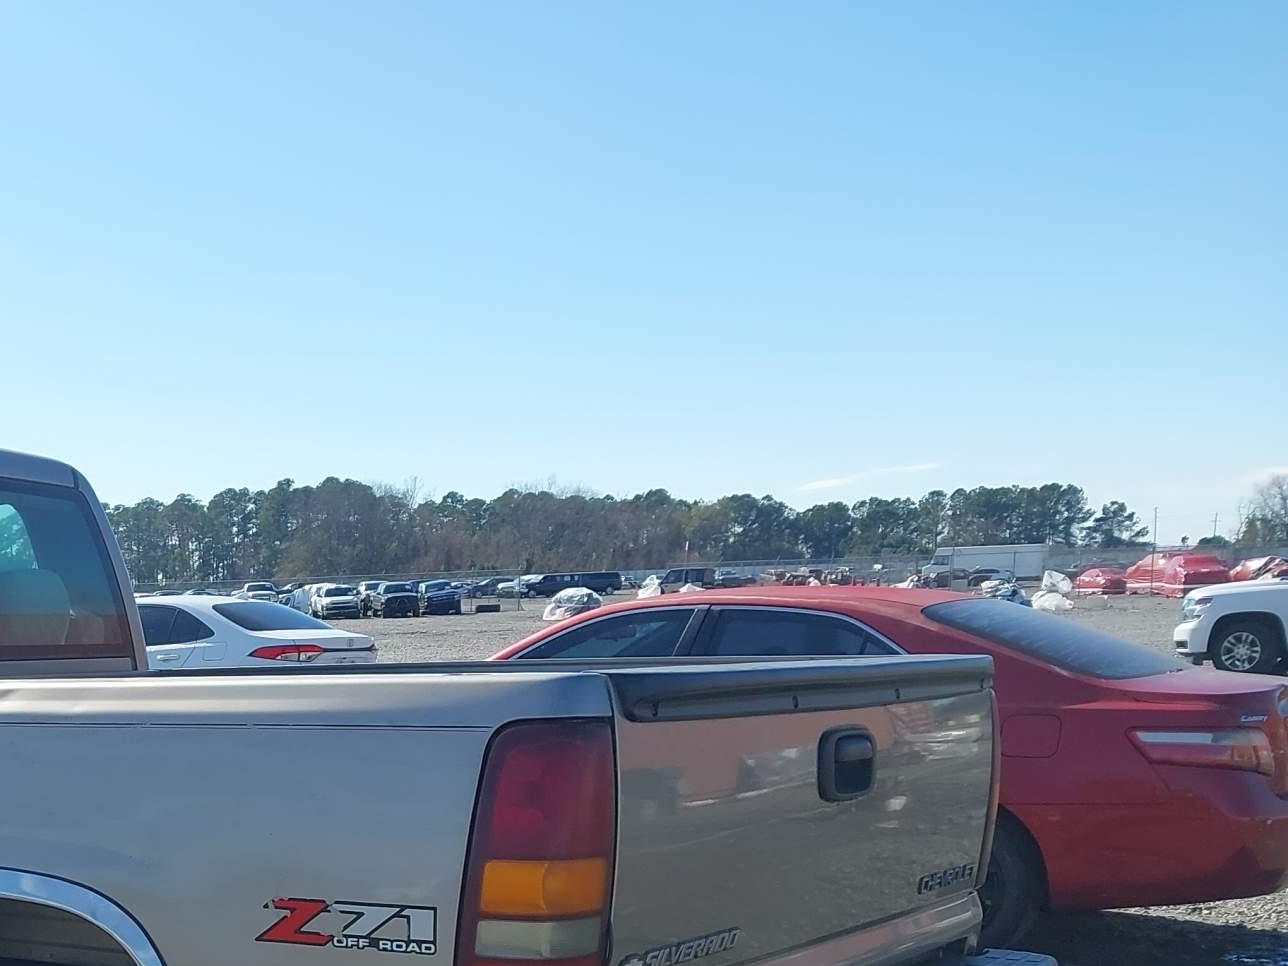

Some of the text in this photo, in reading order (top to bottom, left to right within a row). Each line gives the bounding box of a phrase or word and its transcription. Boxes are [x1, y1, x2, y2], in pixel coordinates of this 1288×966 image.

[255, 898, 437, 946] Z71
[332, 936, 436, 955] OFF ROAD
